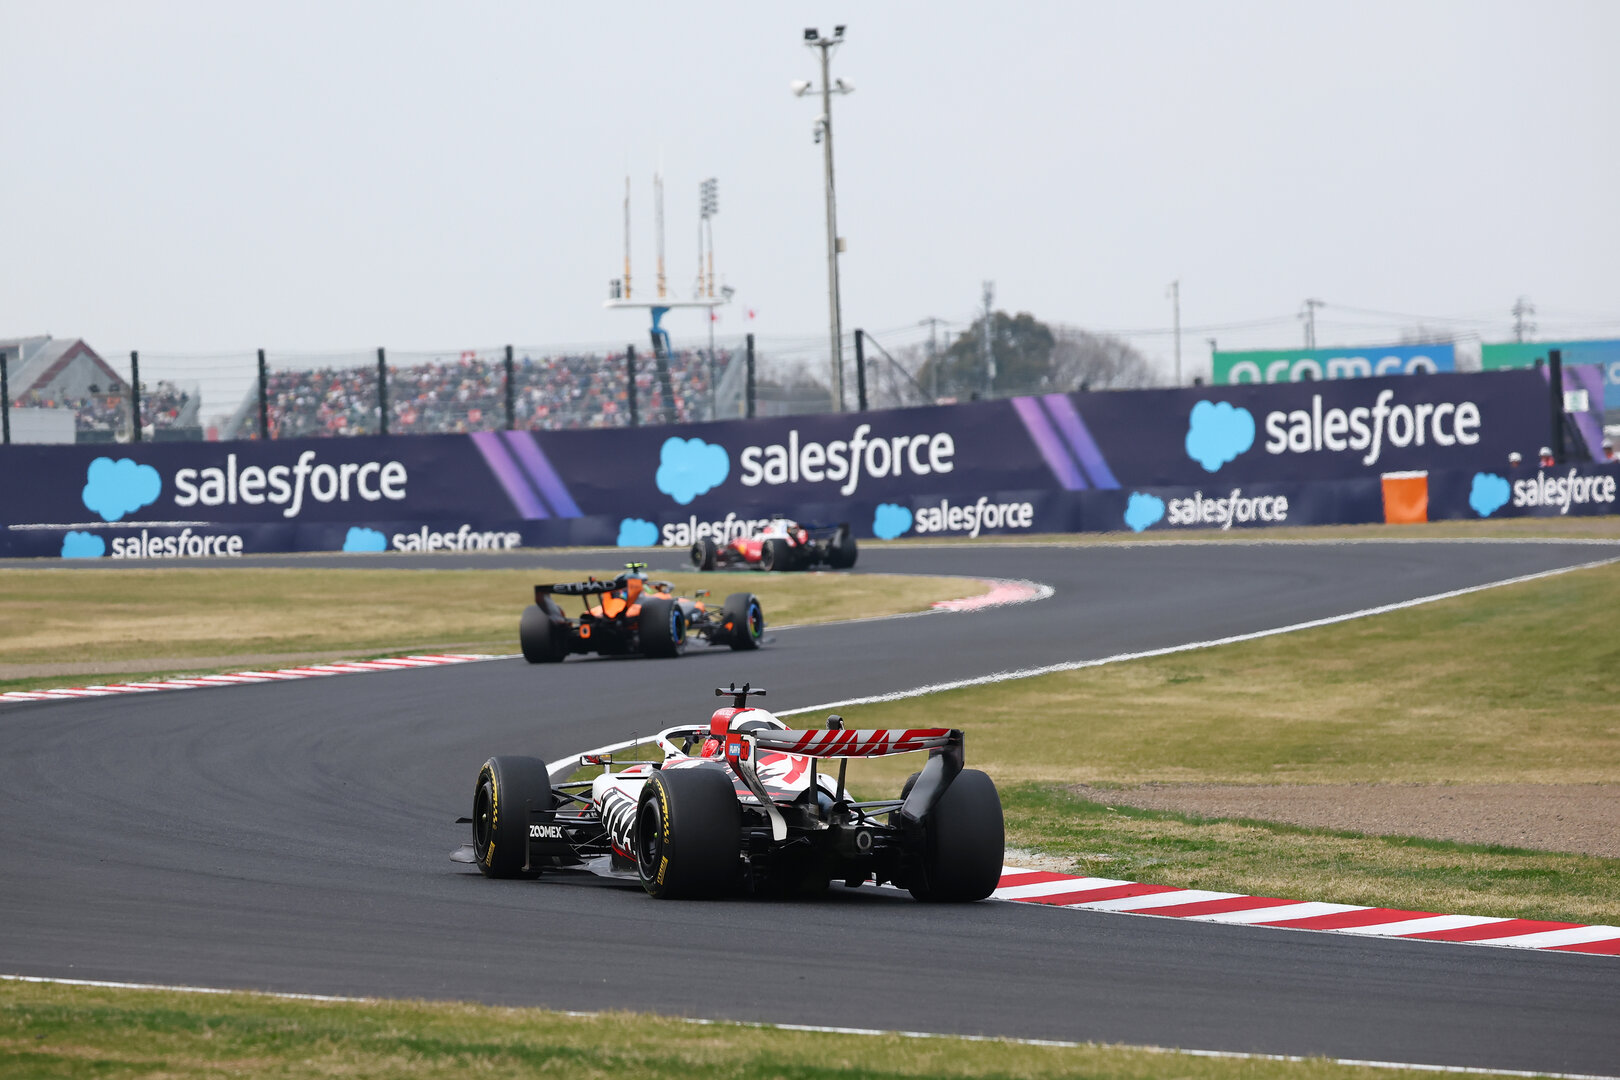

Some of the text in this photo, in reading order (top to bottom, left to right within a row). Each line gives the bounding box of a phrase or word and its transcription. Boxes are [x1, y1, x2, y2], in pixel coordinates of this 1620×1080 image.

[1265, 389, 1481, 466] salesforce
[740, 424, 955, 496] salesforce
[174, 450, 408, 518] salesforce
[1513, 468, 1616, 514] salesforce
[914, 496, 1034, 539] salesforce
[1167, 488, 1289, 531] salesforce
[111, 528, 243, 558] salesforce
[392, 525, 522, 552] salesforce
[553, 581, 617, 593] ETIHAD
[785, 728, 951, 757] HAAS
[529, 825, 563, 839] ZOOMEX
